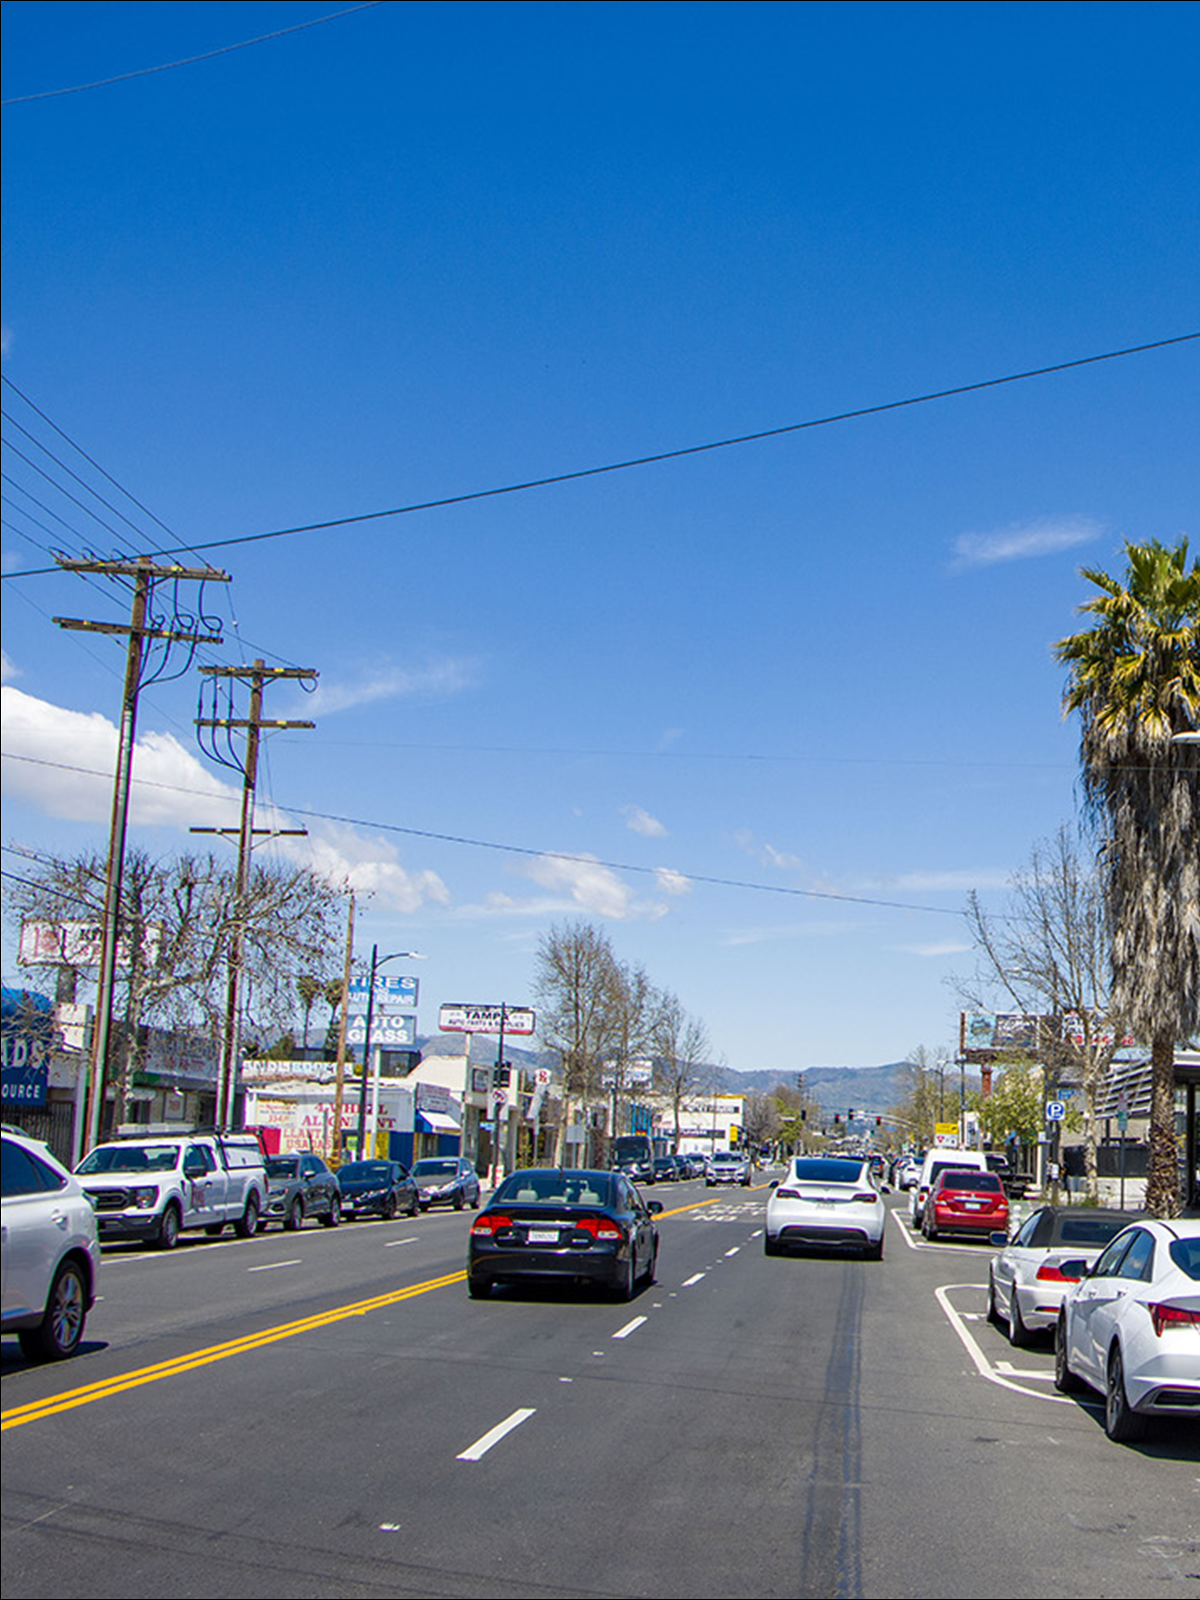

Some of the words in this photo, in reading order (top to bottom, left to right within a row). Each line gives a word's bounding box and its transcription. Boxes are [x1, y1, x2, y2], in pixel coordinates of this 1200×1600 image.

[349, 975, 416, 989] TIRES
[352, 1015, 405, 1029] AUTO
[464, 1010, 510, 1021] TAMPA
[347, 1029, 408, 1042] GLASS
